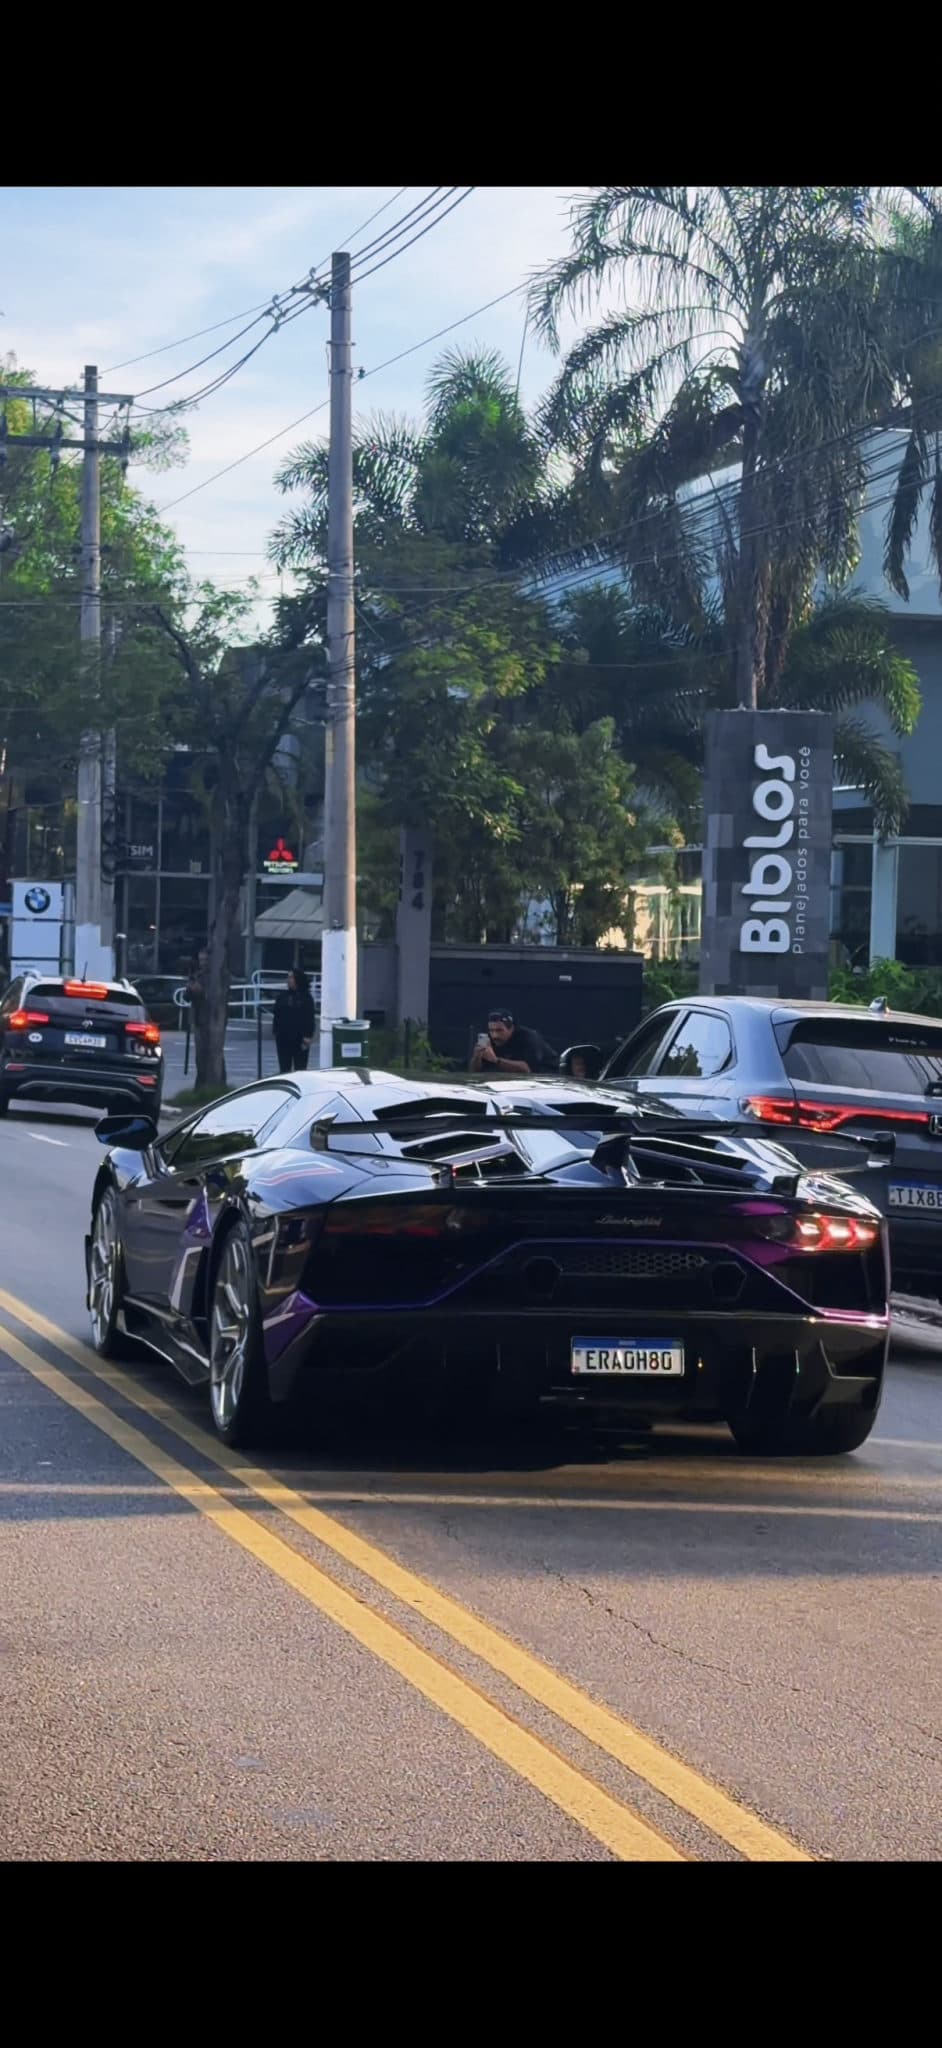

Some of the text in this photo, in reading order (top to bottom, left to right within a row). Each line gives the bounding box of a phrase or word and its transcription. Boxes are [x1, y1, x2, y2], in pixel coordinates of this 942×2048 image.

[792, 746, 811, 954] Planejados para você
